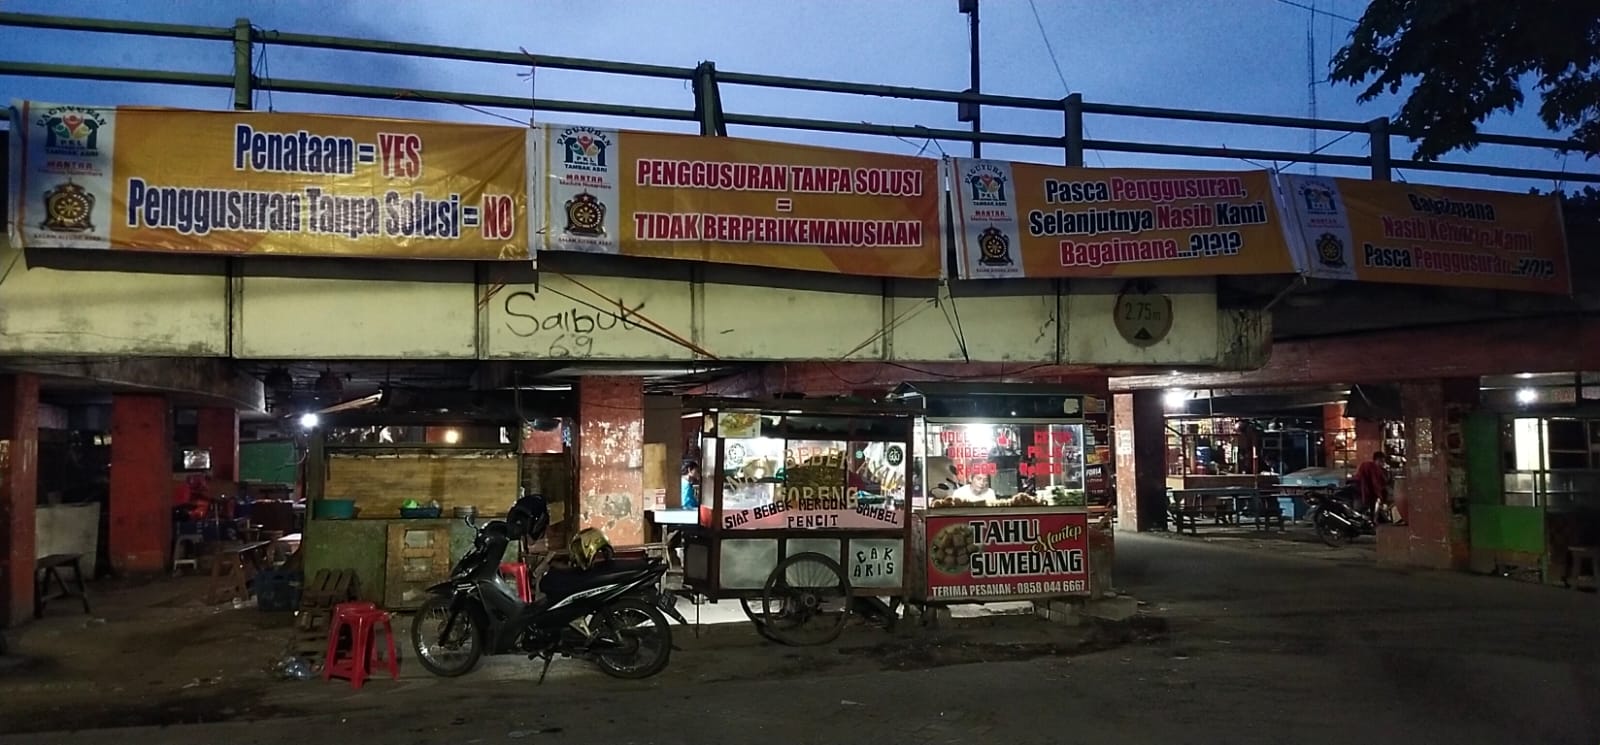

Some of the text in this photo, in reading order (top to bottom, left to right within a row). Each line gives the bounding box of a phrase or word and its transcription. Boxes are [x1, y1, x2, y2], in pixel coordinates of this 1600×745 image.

[235, 123, 422, 179] Penataan = YES
[637, 159, 922, 196] PENGGUSURAN TANPA SOLUSI
[1045, 176, 1247, 203] Pasca Penggusuran,
[128, 177, 514, 239] Penggusuran Tanpa Solusi = NO
[776, 198, 793, 212] =
[634, 213, 922, 247] TIDAK BERPERIKEMANUSIAAN
[1029, 201, 1267, 237] Selanjutnya Nasib Kami
[1381, 214, 1428, 240] Nasib
[1363, 243, 1412, 269] Pasca
[725, 498, 898, 529] SIAP BEBEK MERCON SAMBEL
[788, 515, 839, 528] PENCIT
[970, 519, 1039, 545] TAHU
[857, 547, 894, 563] CAK
[971, 549, 1083, 577] SUMEDANG
[854, 562, 894, 577] ARIS
[932, 586, 968, 598] TERIMA
[970, 584, 1012, 596] PESANAN
[1017, 582, 1042, 594] 0858
[1063, 580, 1085, 592] 6667
